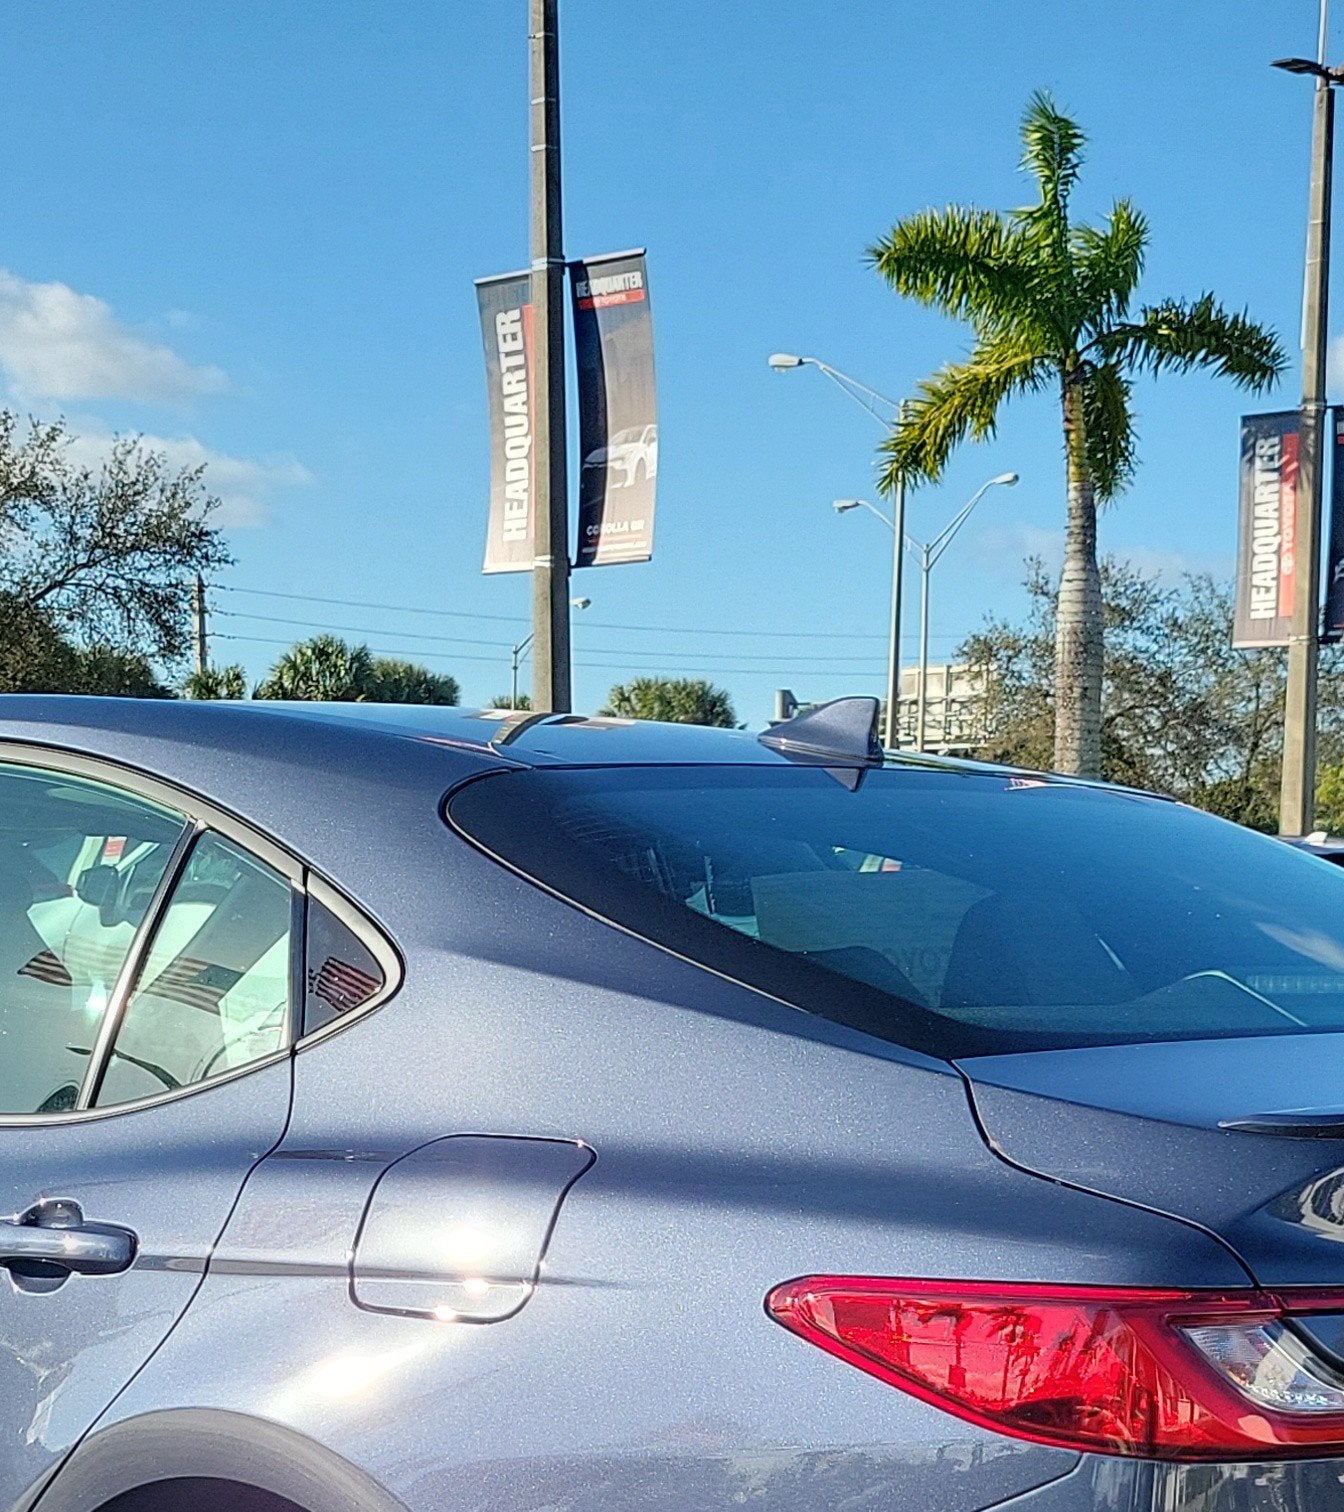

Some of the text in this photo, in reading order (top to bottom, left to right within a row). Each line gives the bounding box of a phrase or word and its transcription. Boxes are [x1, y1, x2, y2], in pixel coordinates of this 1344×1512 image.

[495, 308, 531, 542] HEADQUARTER
[1250, 435, 1282, 619] HEADQUARTER
[1281, 487, 1297, 556] TOYOTA
